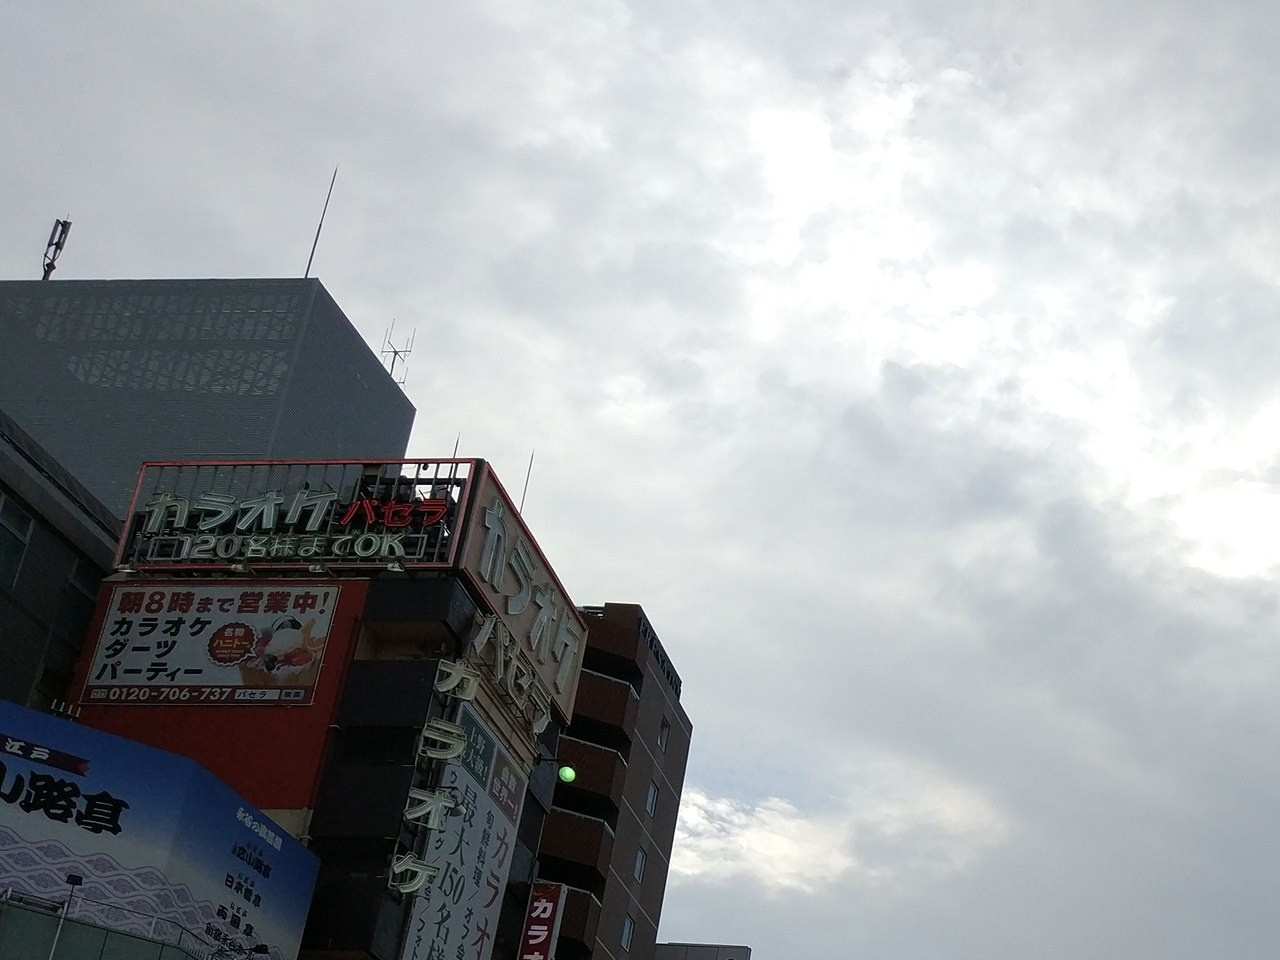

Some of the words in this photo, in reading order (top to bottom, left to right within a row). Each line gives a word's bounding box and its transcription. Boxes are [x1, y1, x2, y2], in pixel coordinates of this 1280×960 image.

[146, 490, 337, 532] カラオケ
[339, 499, 448, 528] パセラ
[480, 499, 579, 695] カラオケ
[110, 617, 212, 637] カラオケ
[104, 639, 178, 658] ダーツ
[96, 662, 204, 682] パーティー
[109, 687, 233, 701] 0120-706-737
[236, 690, 268, 699] パセラ
[388, 658, 481, 894] カラオケ
